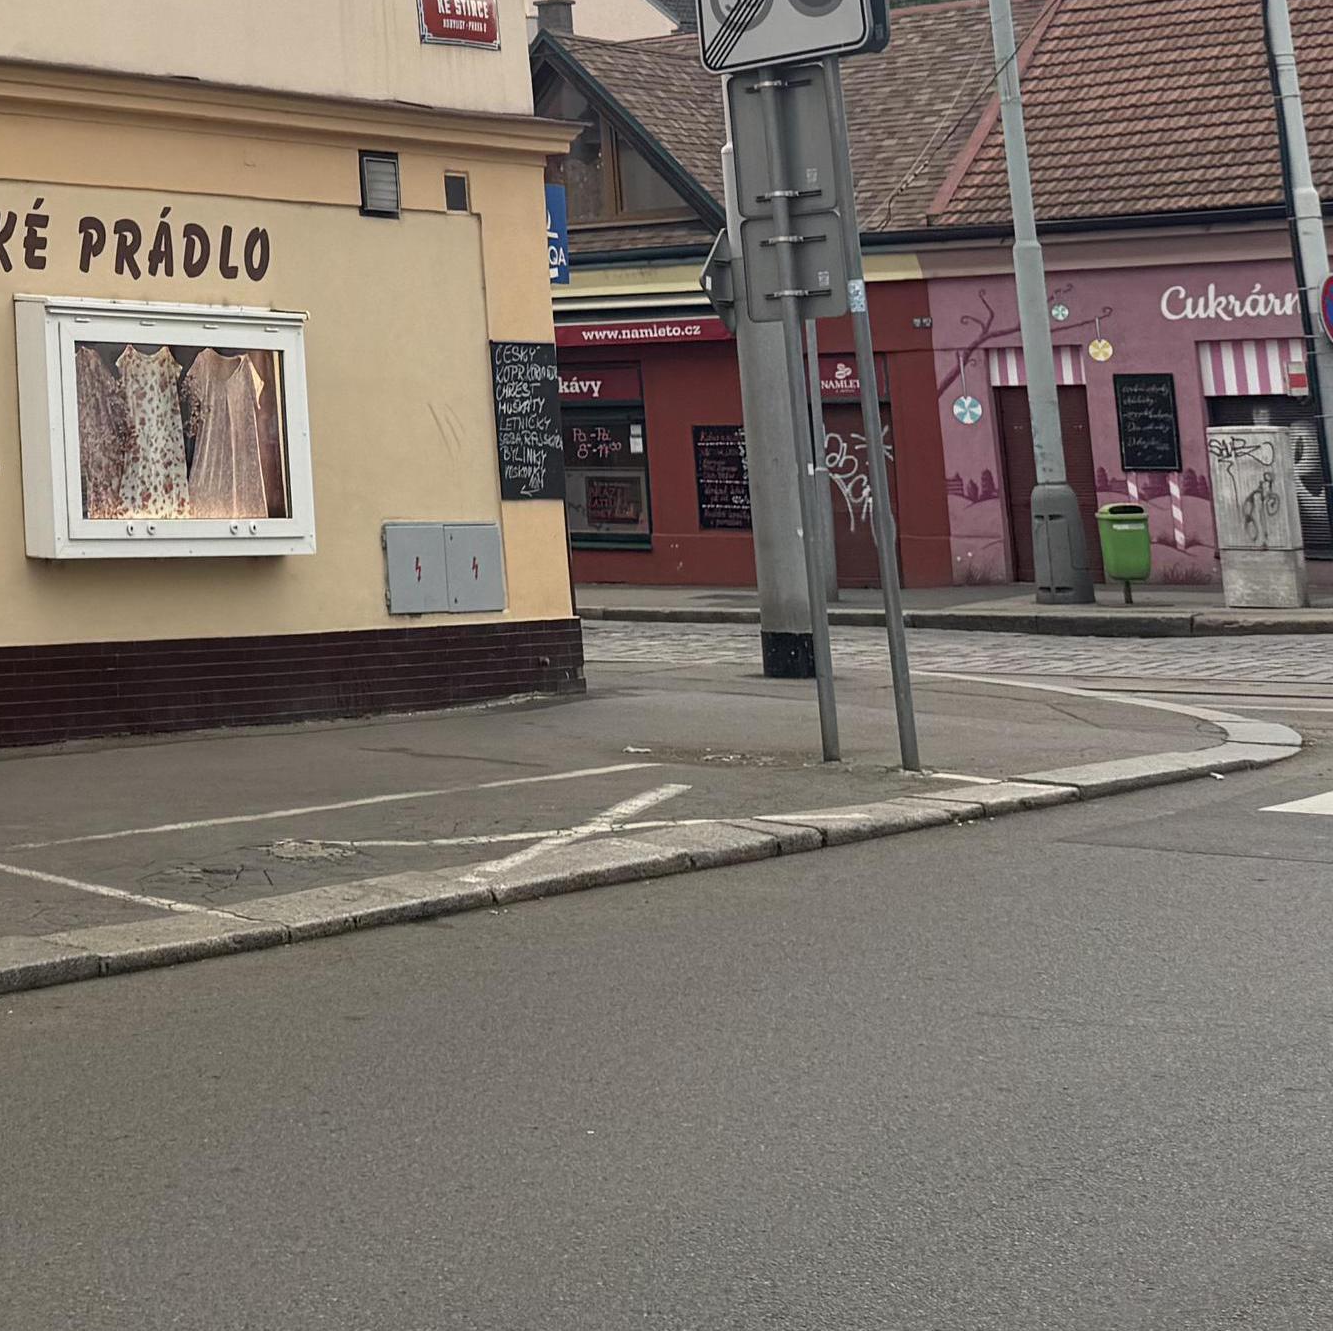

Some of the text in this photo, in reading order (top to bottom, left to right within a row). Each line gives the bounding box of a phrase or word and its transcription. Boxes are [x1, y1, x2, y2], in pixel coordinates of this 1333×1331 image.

[79, 207, 270, 281] PRÁDLO
[582, 324, 701, 340] www.namleto.cz
[558, 376, 601, 397] kávy
